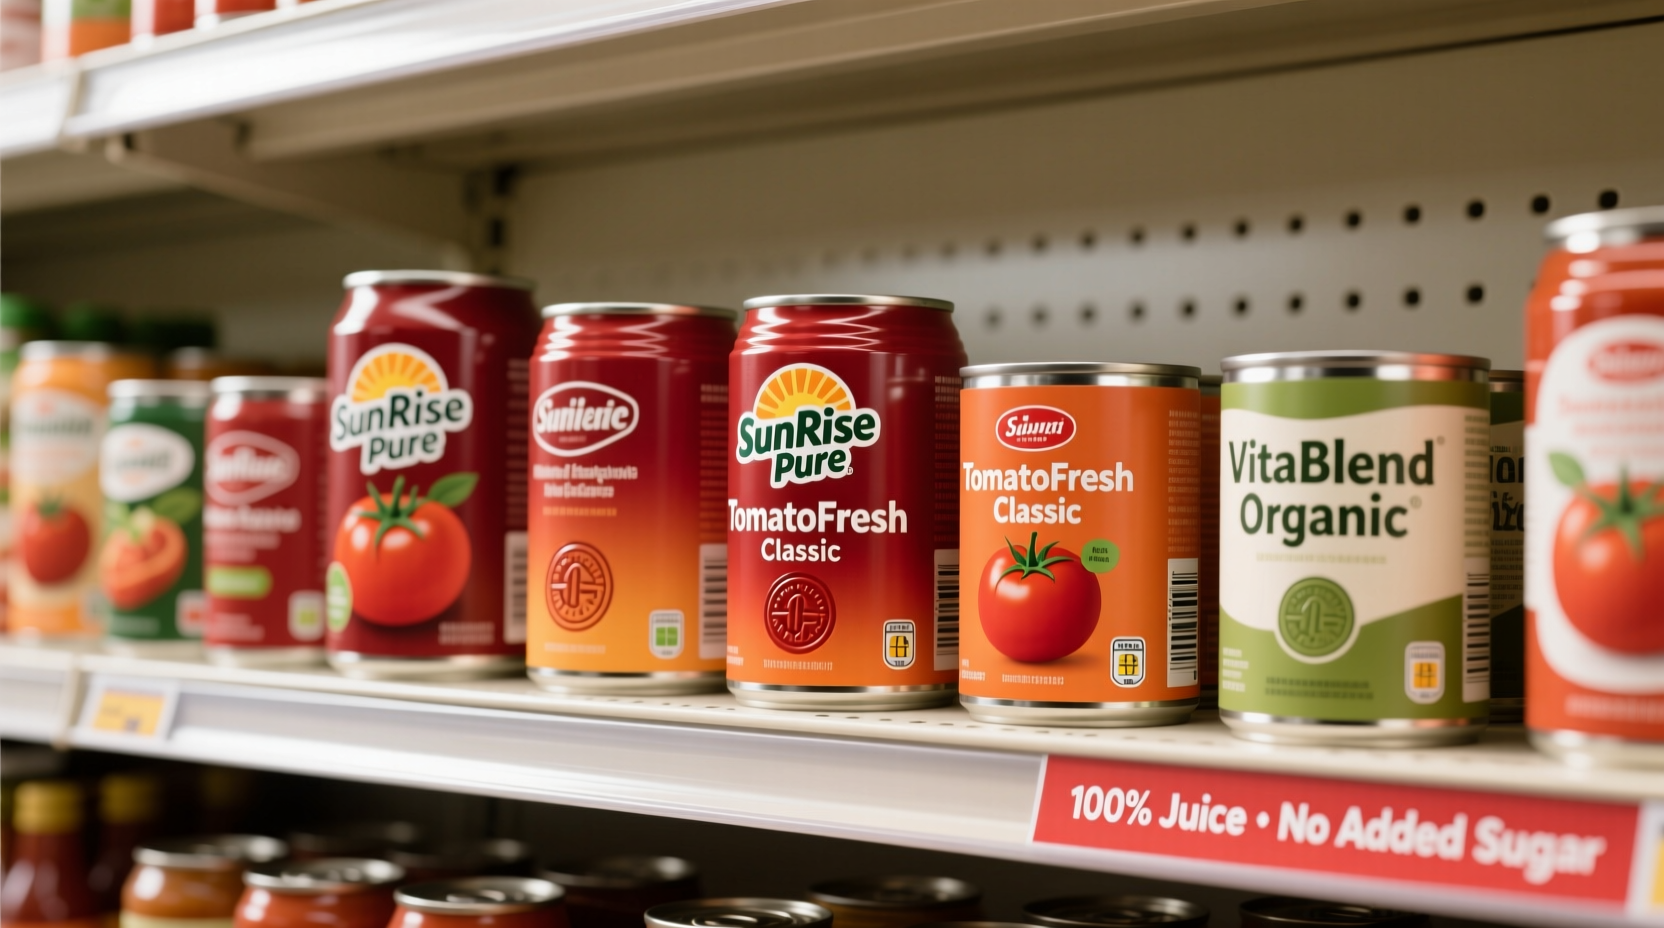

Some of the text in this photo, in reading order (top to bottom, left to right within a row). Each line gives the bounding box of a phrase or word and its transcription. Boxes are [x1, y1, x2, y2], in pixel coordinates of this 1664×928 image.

[336, 390, 464, 441] SunRise
[738, 407, 876, 458] SunRise
[368, 432, 438, 464] Pure
[1229, 438, 1434, 485] VitaBlend
[774, 449, 847, 483] Pure
[963, 461, 1134, 492] TomatoFresh
[728, 498, 908, 533] TomatoFresh
[993, 496, 1081, 524] Classic
[1240, 492, 1408, 547] Organic
[761, 537, 841, 562] Classic
[1071, 785, 1153, 826] 100%
[1158, 792, 1247, 836] Juice
[1276, 801, 1330, 845] No
[1333, 805, 1468, 861] Added
[1472, 815, 1607, 885] Sugar
